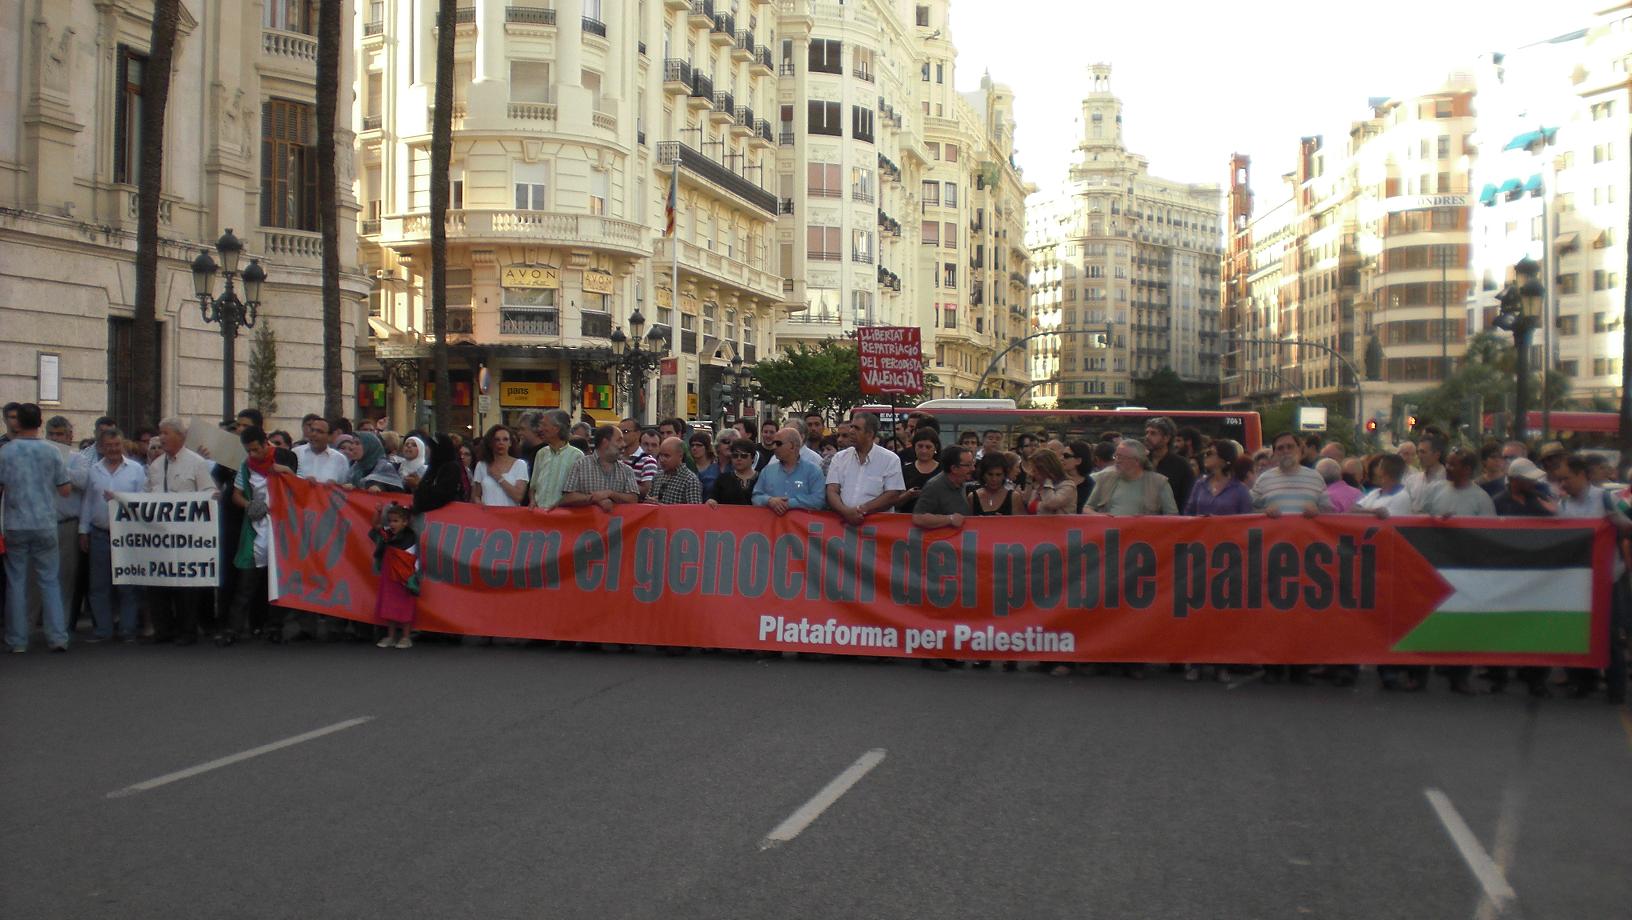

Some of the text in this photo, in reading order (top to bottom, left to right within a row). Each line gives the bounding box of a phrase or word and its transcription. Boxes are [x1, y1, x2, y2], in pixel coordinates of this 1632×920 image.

[505, 269, 556, 279] AVON
[585, 274, 612, 284] AVON
[860, 356, 878, 368] DEL
[507, 387, 529, 397] pans
[115, 501, 211, 522] ATUREM
[112, 533, 216, 548] el GENOCIDI del
[114, 558, 215, 578] poble PALESTÍ
[574, 515, 623, 592] el
[632, 522, 877, 603] genocidi
[890, 527, 976, 609] del
[992, 527, 1156, 616] poble
[1172, 526, 1379, 618] palestí
[759, 615, 1075, 654] Plataforma per Palestina
